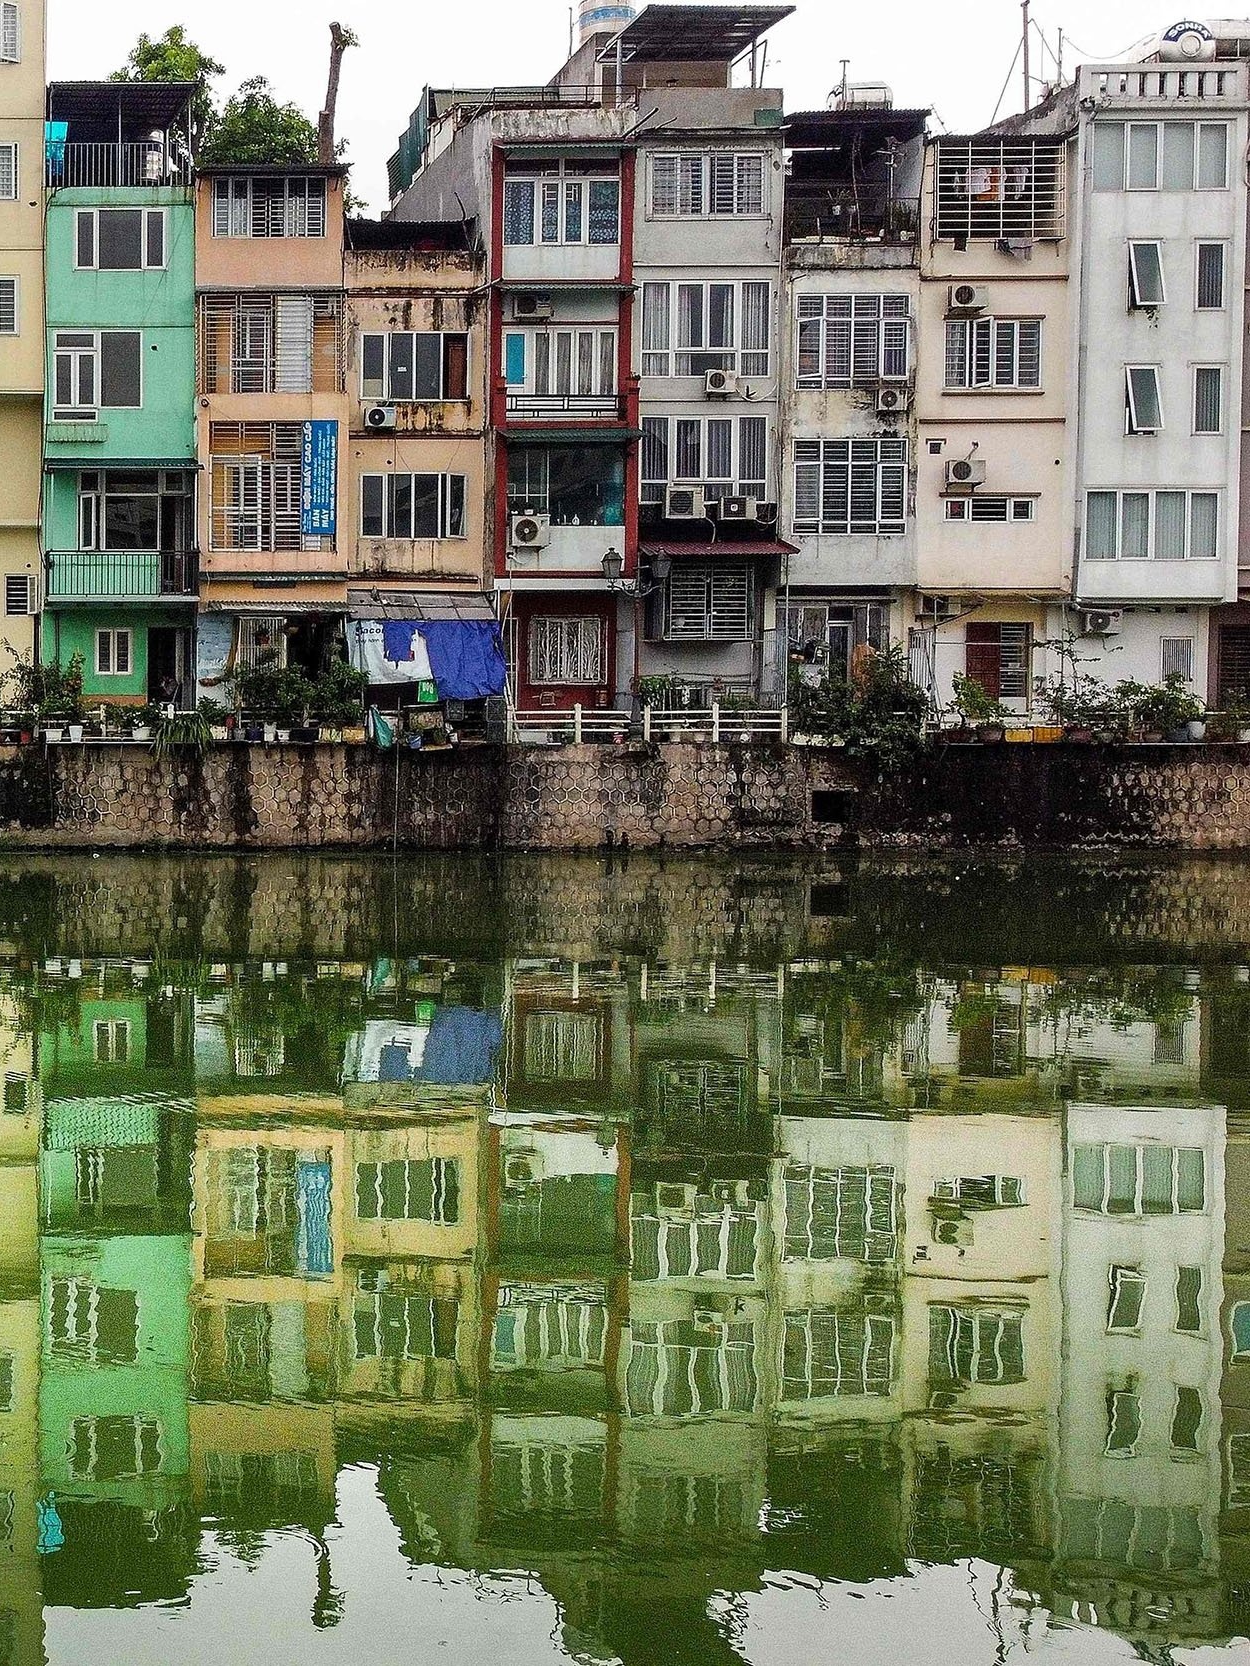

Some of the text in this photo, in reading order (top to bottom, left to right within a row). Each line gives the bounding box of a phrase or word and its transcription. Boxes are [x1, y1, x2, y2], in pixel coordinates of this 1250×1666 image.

[303, 422, 312, 441] CẤP
[303, 465, 312, 486] MÁY
[321, 509, 329, 527] MÁY
